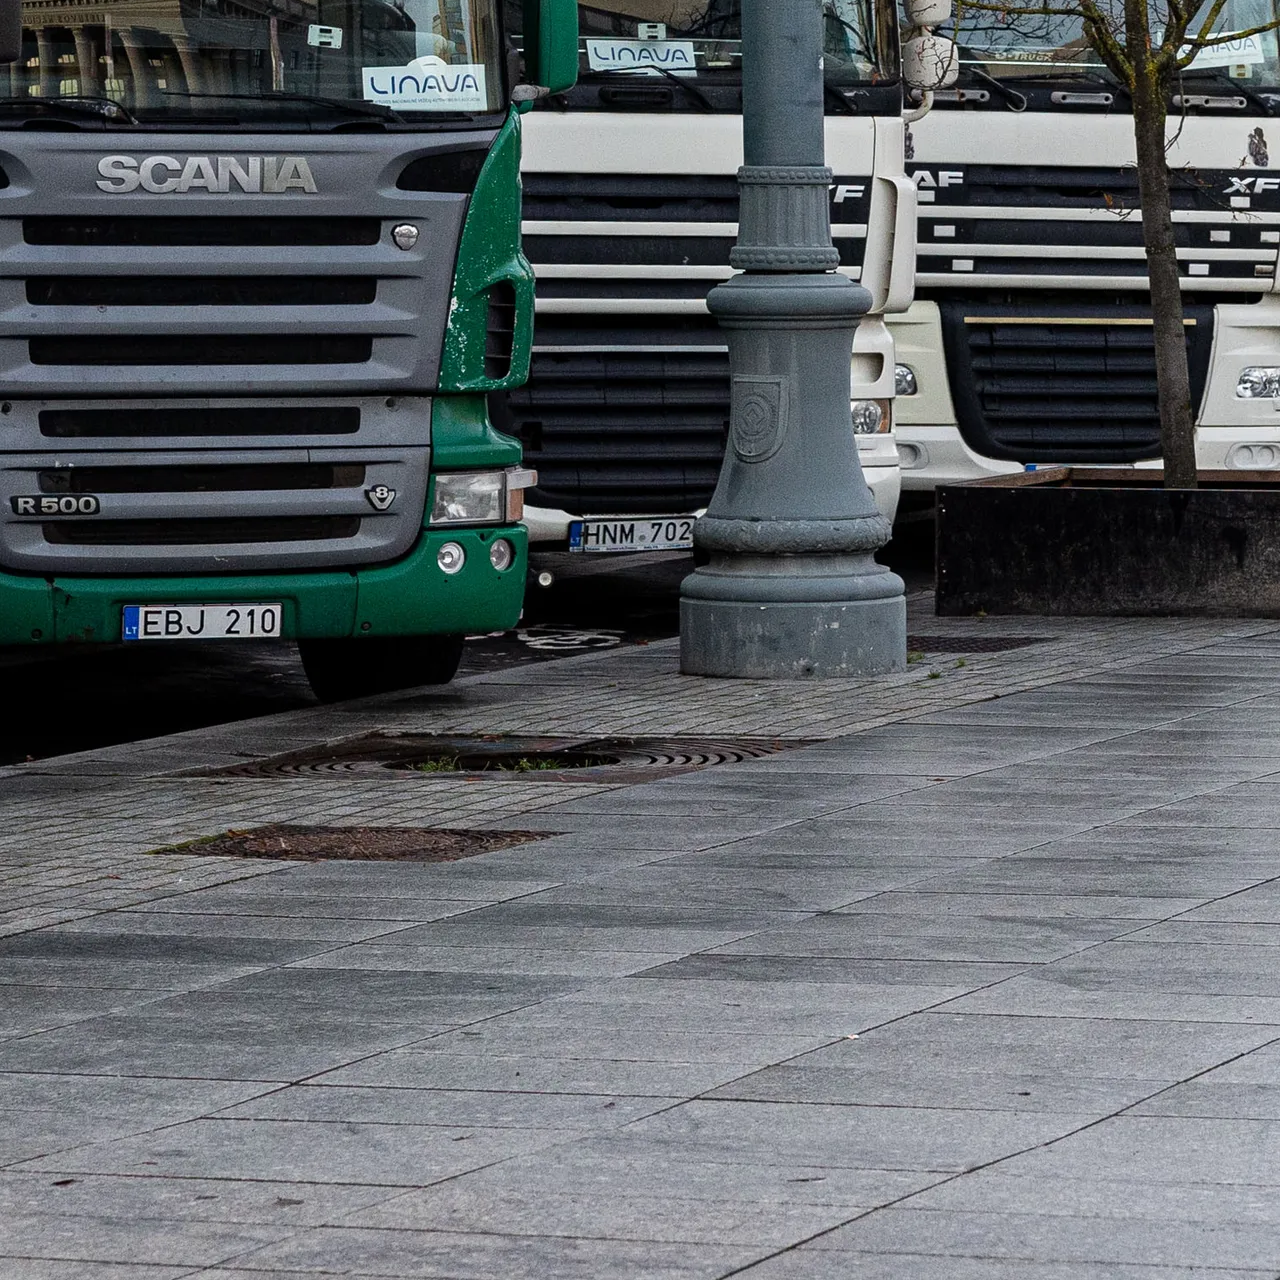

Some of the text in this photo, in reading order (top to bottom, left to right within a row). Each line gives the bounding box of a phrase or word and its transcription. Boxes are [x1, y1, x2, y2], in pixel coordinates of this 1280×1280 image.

[593, 47, 688, 63] LINAVA
[370, 74, 479, 95] LINAVA
[96, 155, 318, 194] SCANIA
[910, 170, 964, 187] AF
[1222, 177, 1280, 194] XF
[17, 497, 96, 513] R 500
[585, 523, 635, 545] HNM
[651, 521, 691, 542] 702
[125, 608, 276, 636] LT EBJ 210
